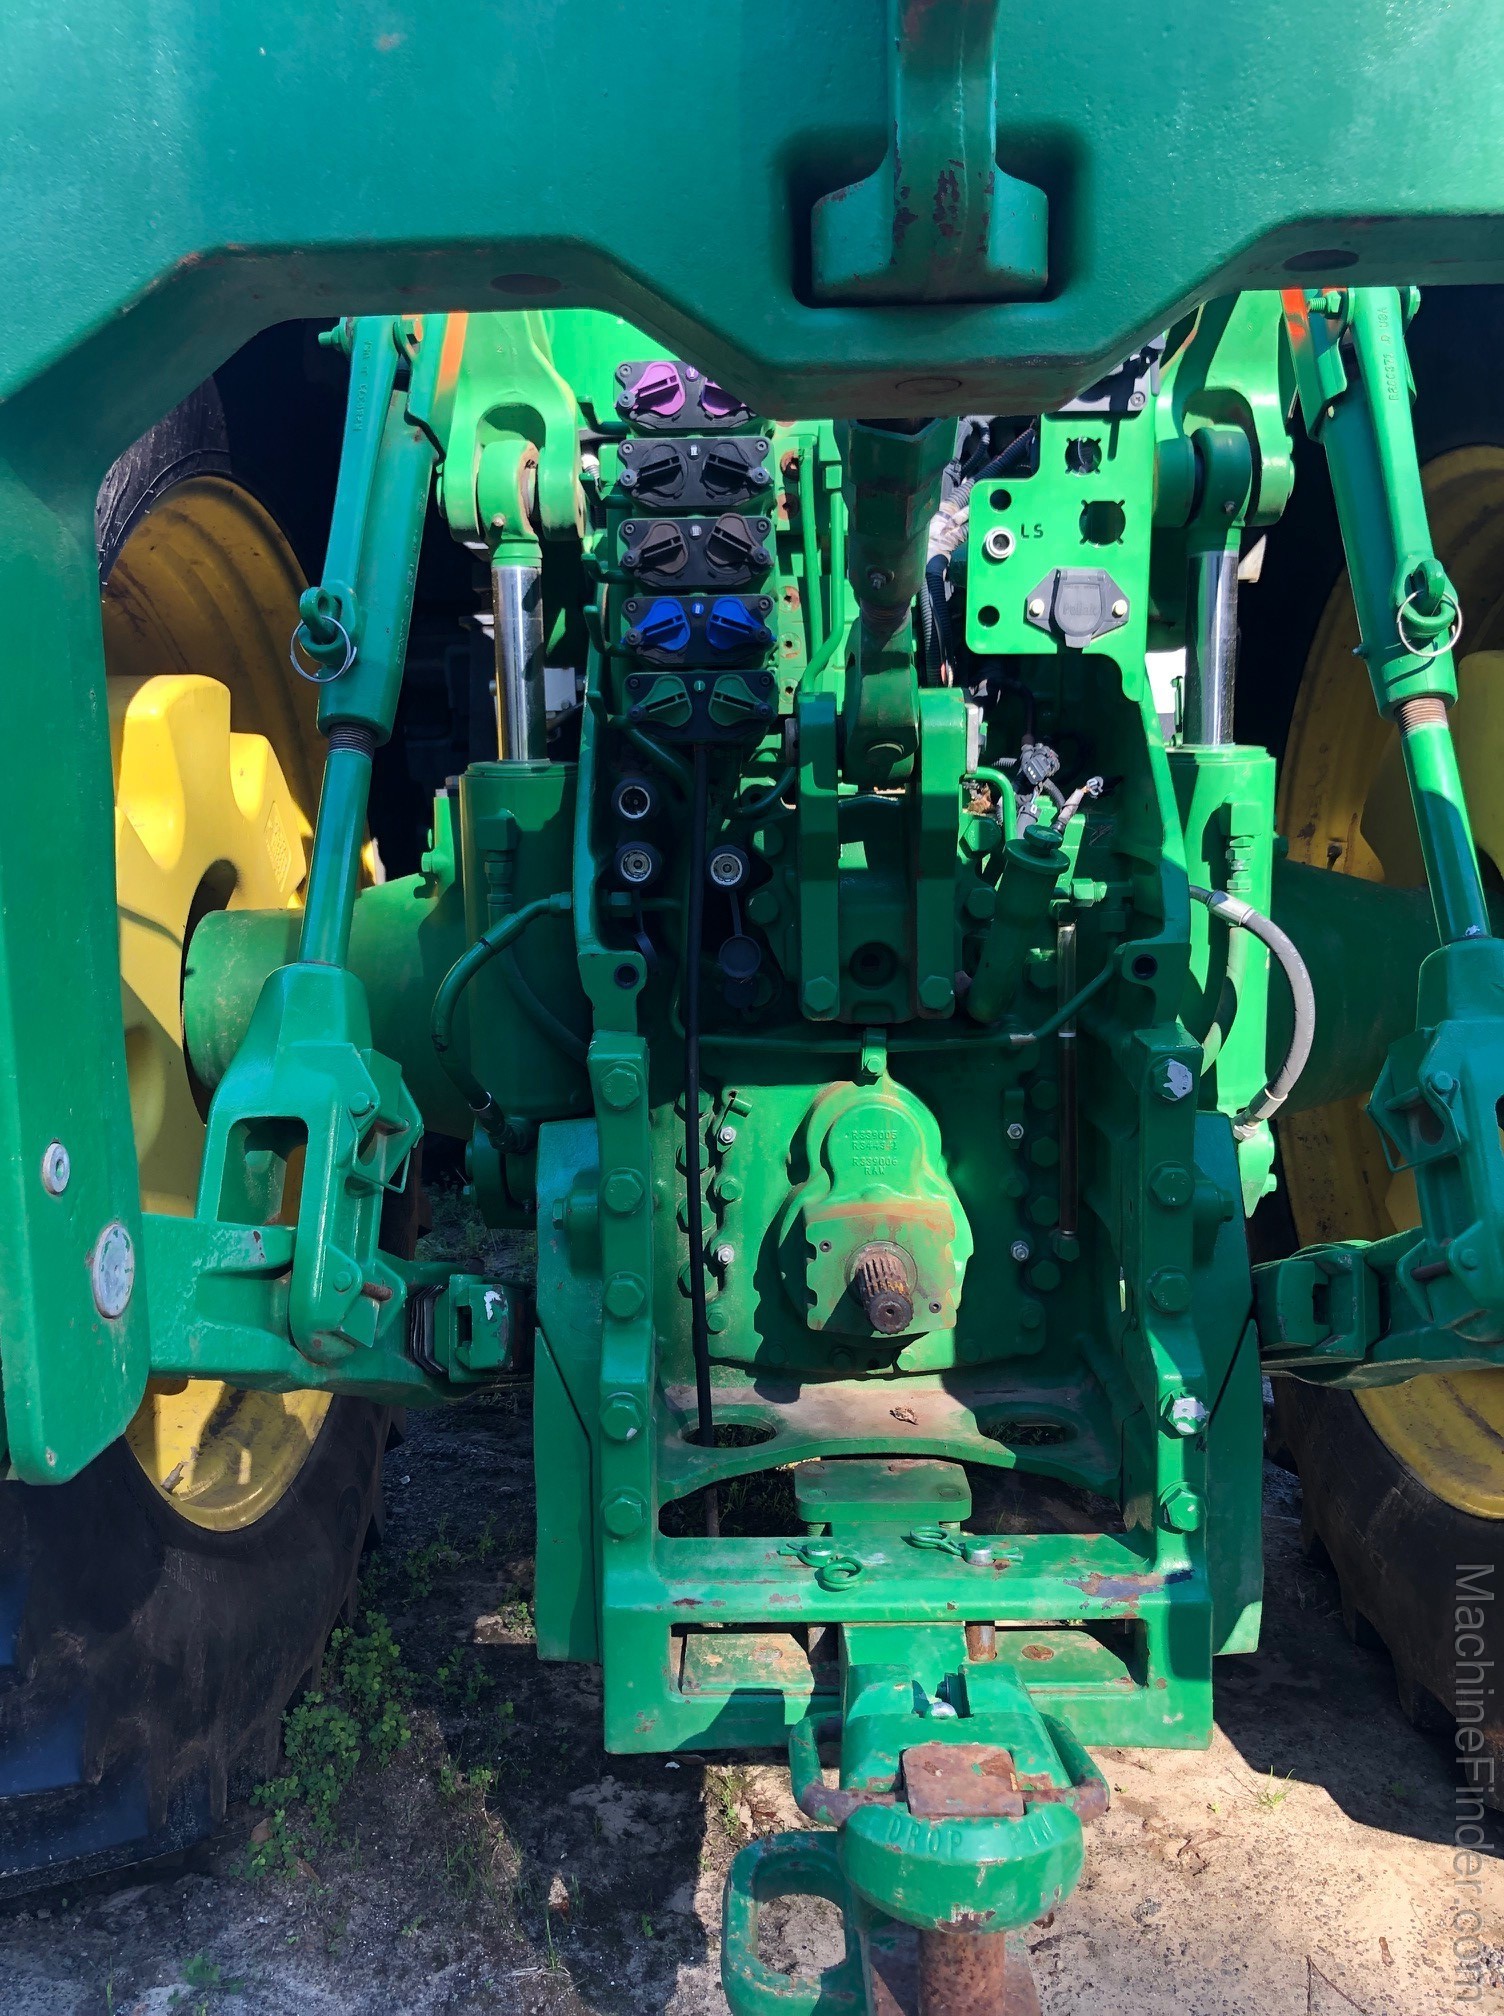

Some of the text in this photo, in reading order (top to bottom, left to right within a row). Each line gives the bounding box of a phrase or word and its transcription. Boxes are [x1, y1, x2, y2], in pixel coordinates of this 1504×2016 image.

[1021, 524, 1044, 539] LS
[864, 1166, 886, 1176] RAW
[887, 1815, 962, 1858] DROP
